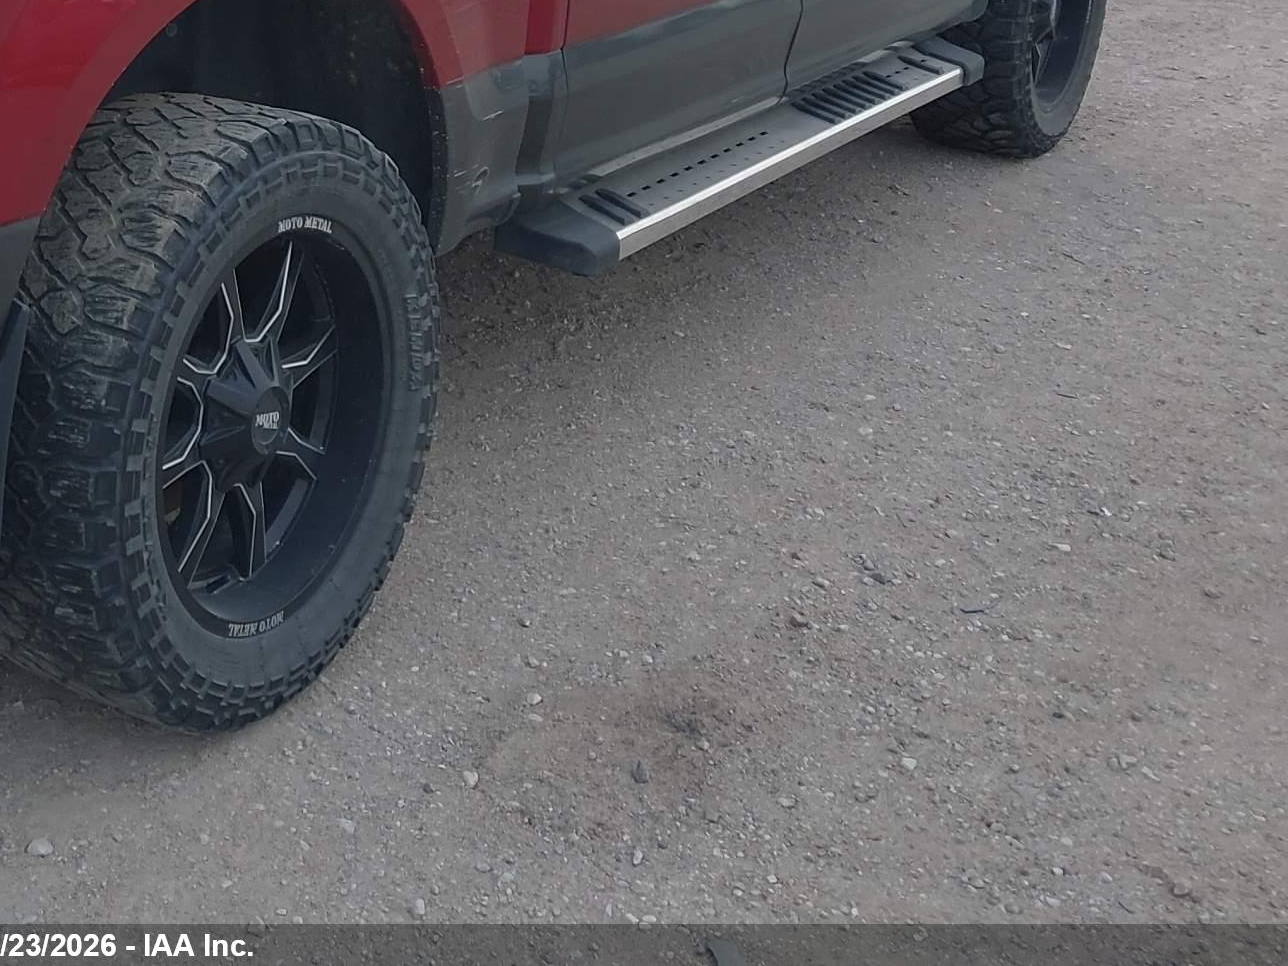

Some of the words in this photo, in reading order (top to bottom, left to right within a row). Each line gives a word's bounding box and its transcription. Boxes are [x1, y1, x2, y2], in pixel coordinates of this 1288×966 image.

[277, 216, 303, 233] MOTO
[304, 215, 332, 234] METAL
[255, 411, 280, 427] MOTO
[228, 622, 258, 638] METAL
[259, 610, 284, 634] MOTO
